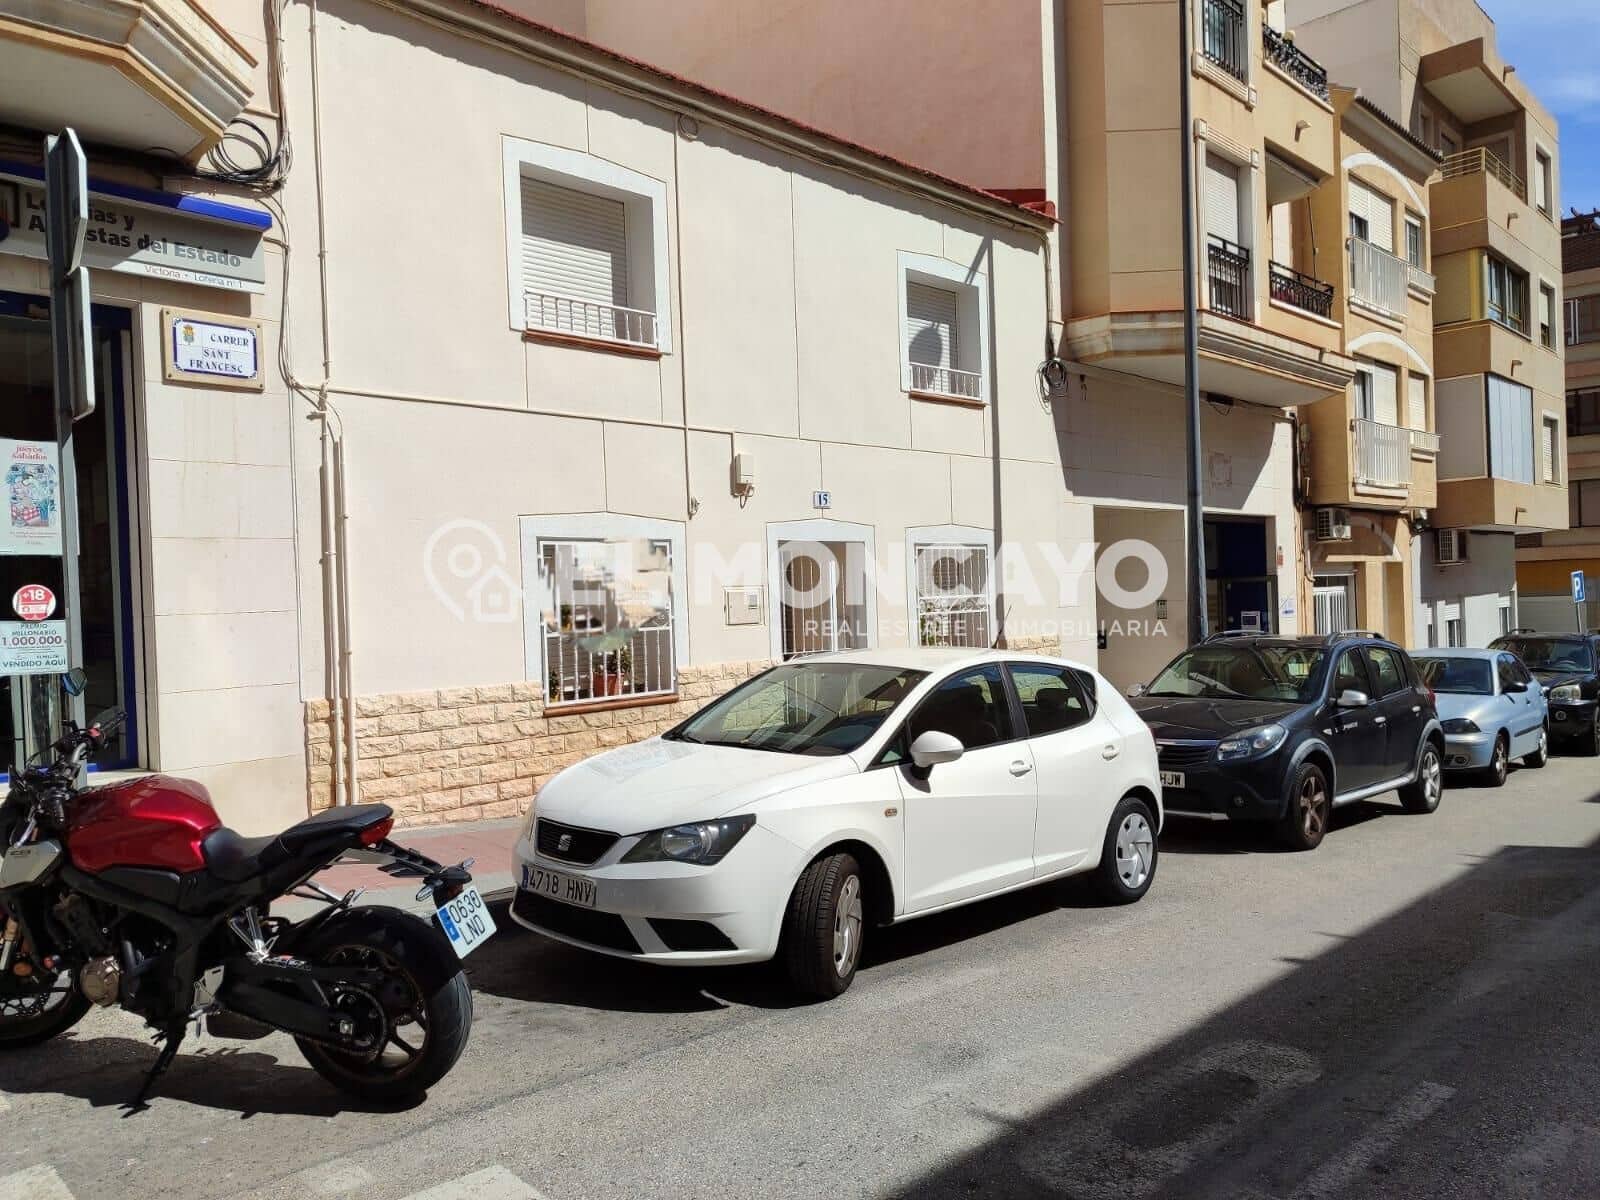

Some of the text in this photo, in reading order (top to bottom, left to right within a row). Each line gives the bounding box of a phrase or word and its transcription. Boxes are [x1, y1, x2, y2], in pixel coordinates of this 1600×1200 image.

[124, 215, 135, 231] y
[29, 214, 241, 267] Astas del Estado
[144, 265, 181, 279] Victoria
[210, 333, 249, 346] CARRER
[203, 349, 230, 359] SANT
[190, 360, 243, 373] FRANCESC
[819, 494, 828, 505] 15
[22, 589, 45, 601] +18
[2, 635, 62, 646] 1.000.000
[1160, 773, 1181, 785] HJW
[529, 870, 560, 894] 4718
[449, 890, 481, 923] 0630
[458, 914, 486, 945] LND
